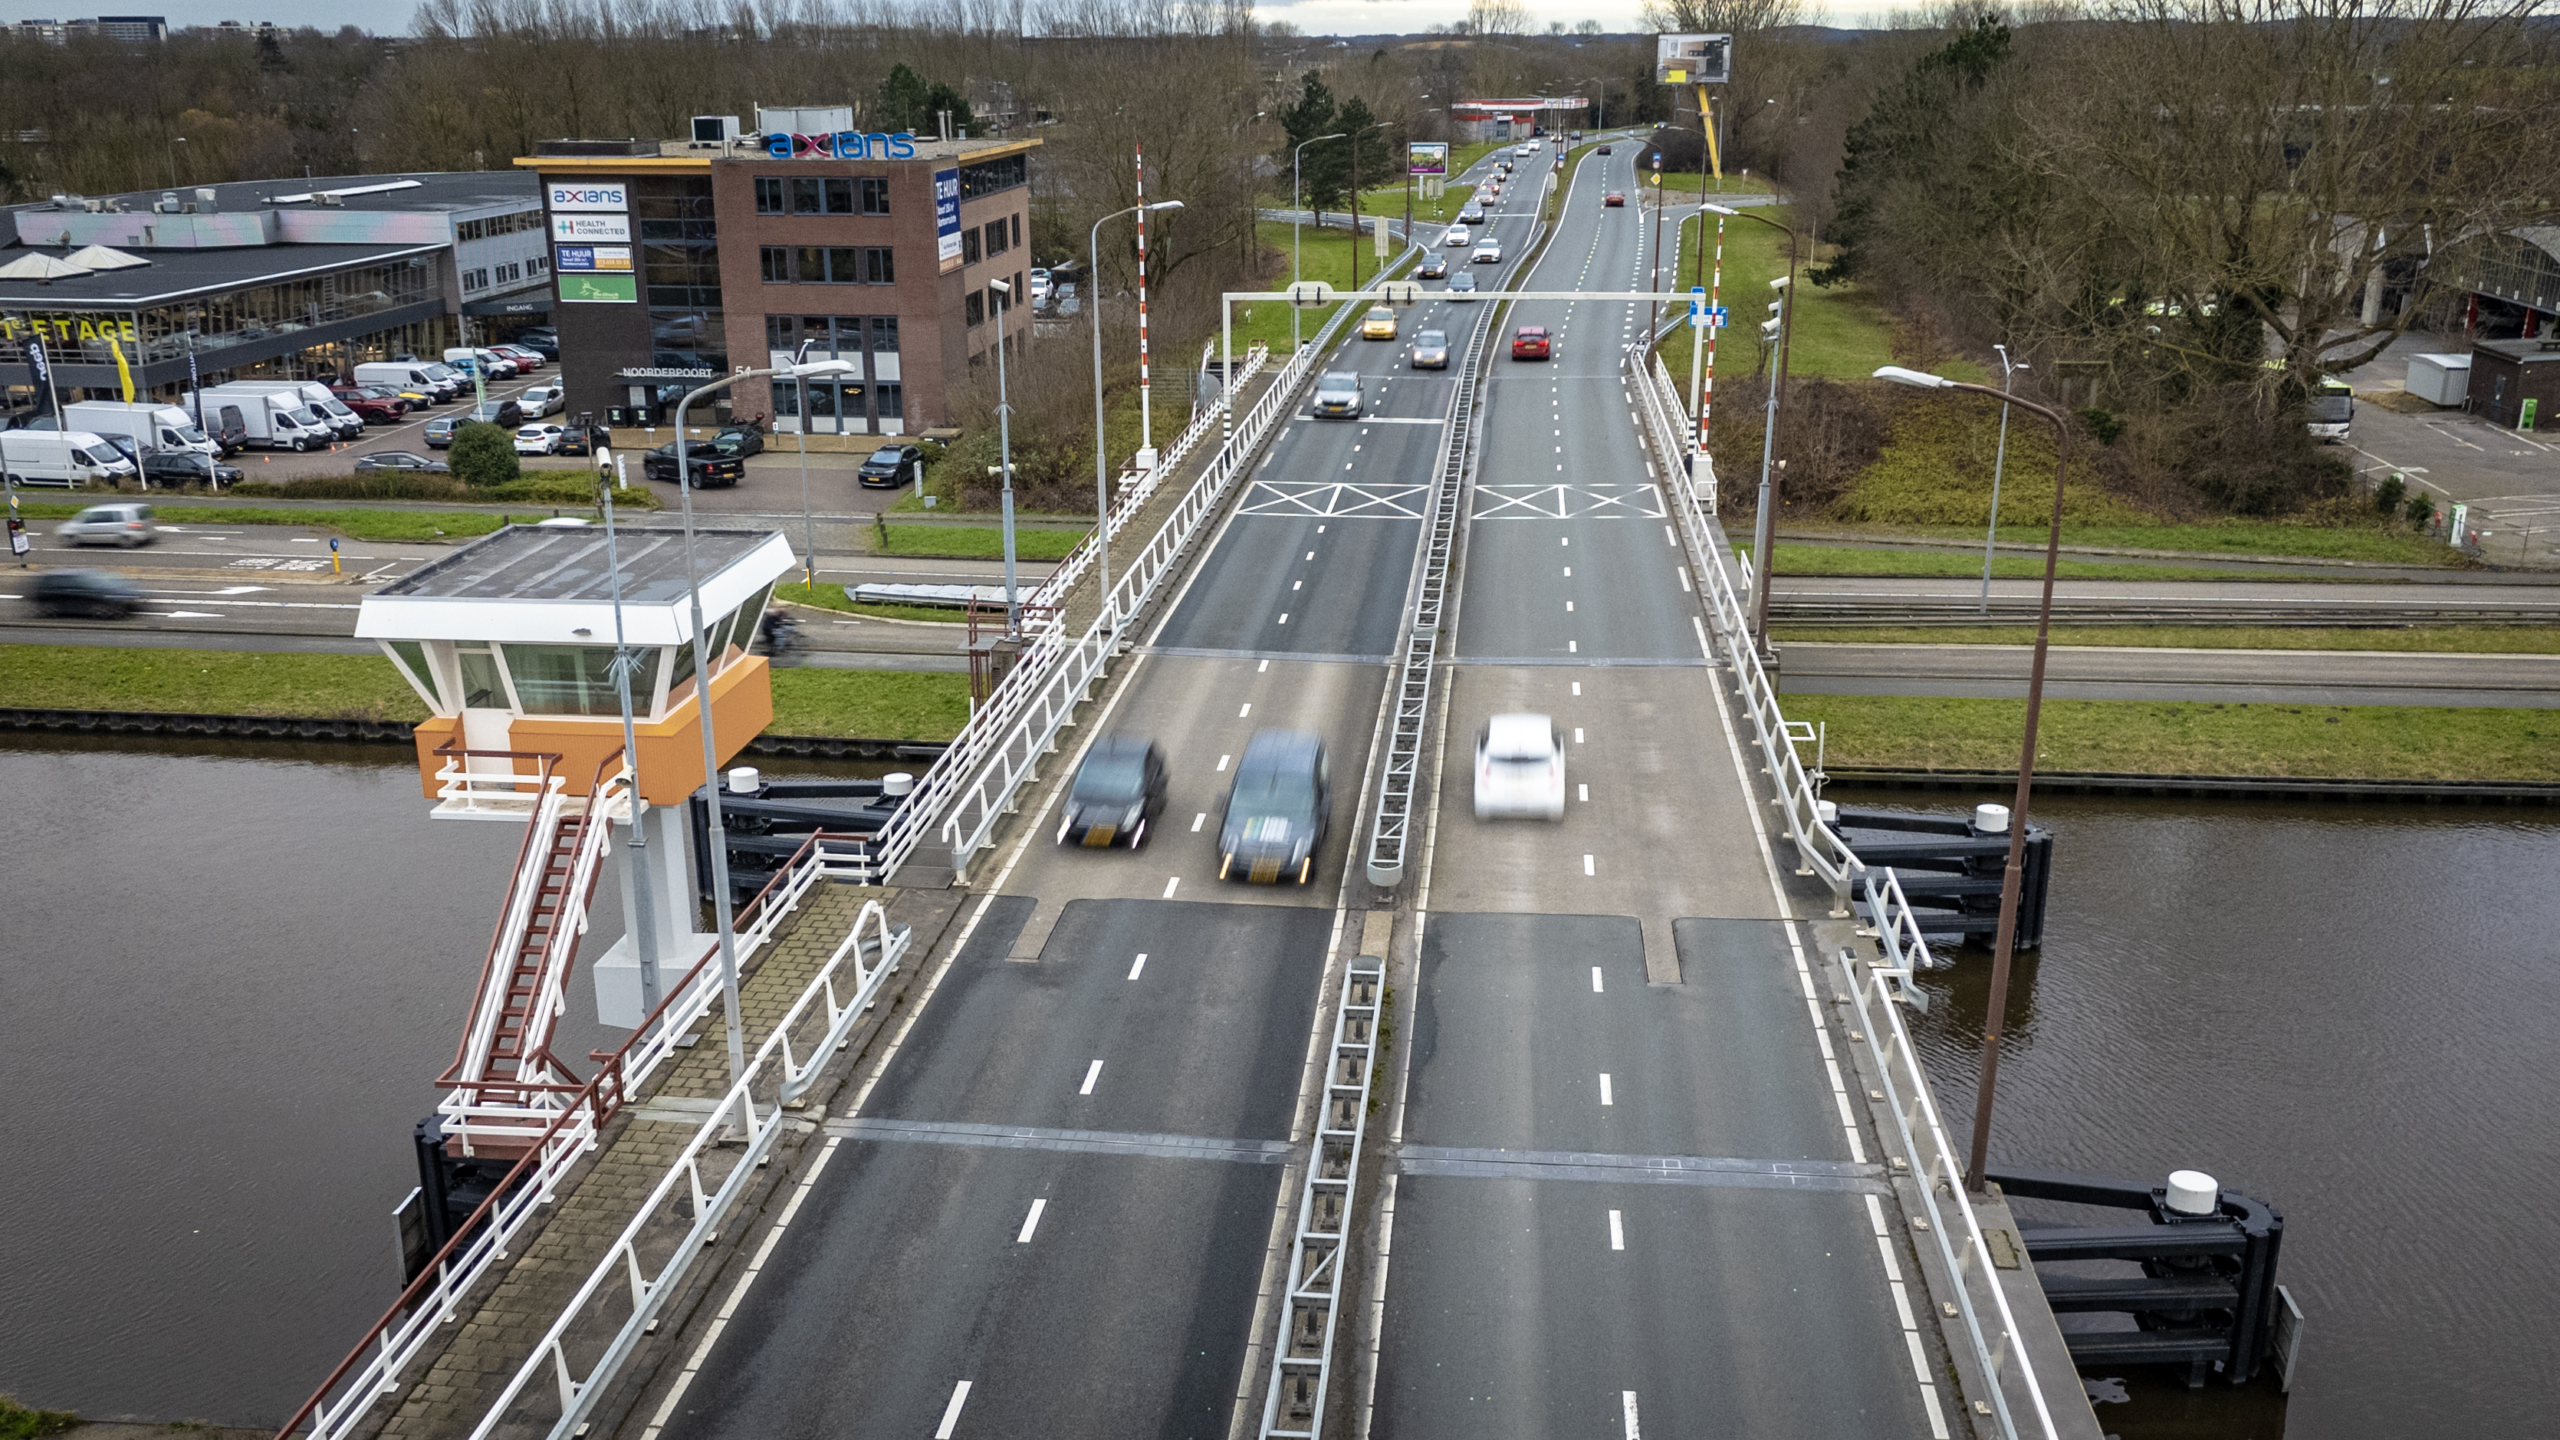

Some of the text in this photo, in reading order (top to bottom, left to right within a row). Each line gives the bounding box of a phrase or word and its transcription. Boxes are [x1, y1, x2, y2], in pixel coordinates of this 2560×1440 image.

[769, 132, 915, 159] axians
[554, 190, 623, 203] axians
[561, 250, 592, 258] TE HUUR
[32, 320, 136, 342] ETAGE
[622, 366, 752, 378] NOORDERPOORT 54
